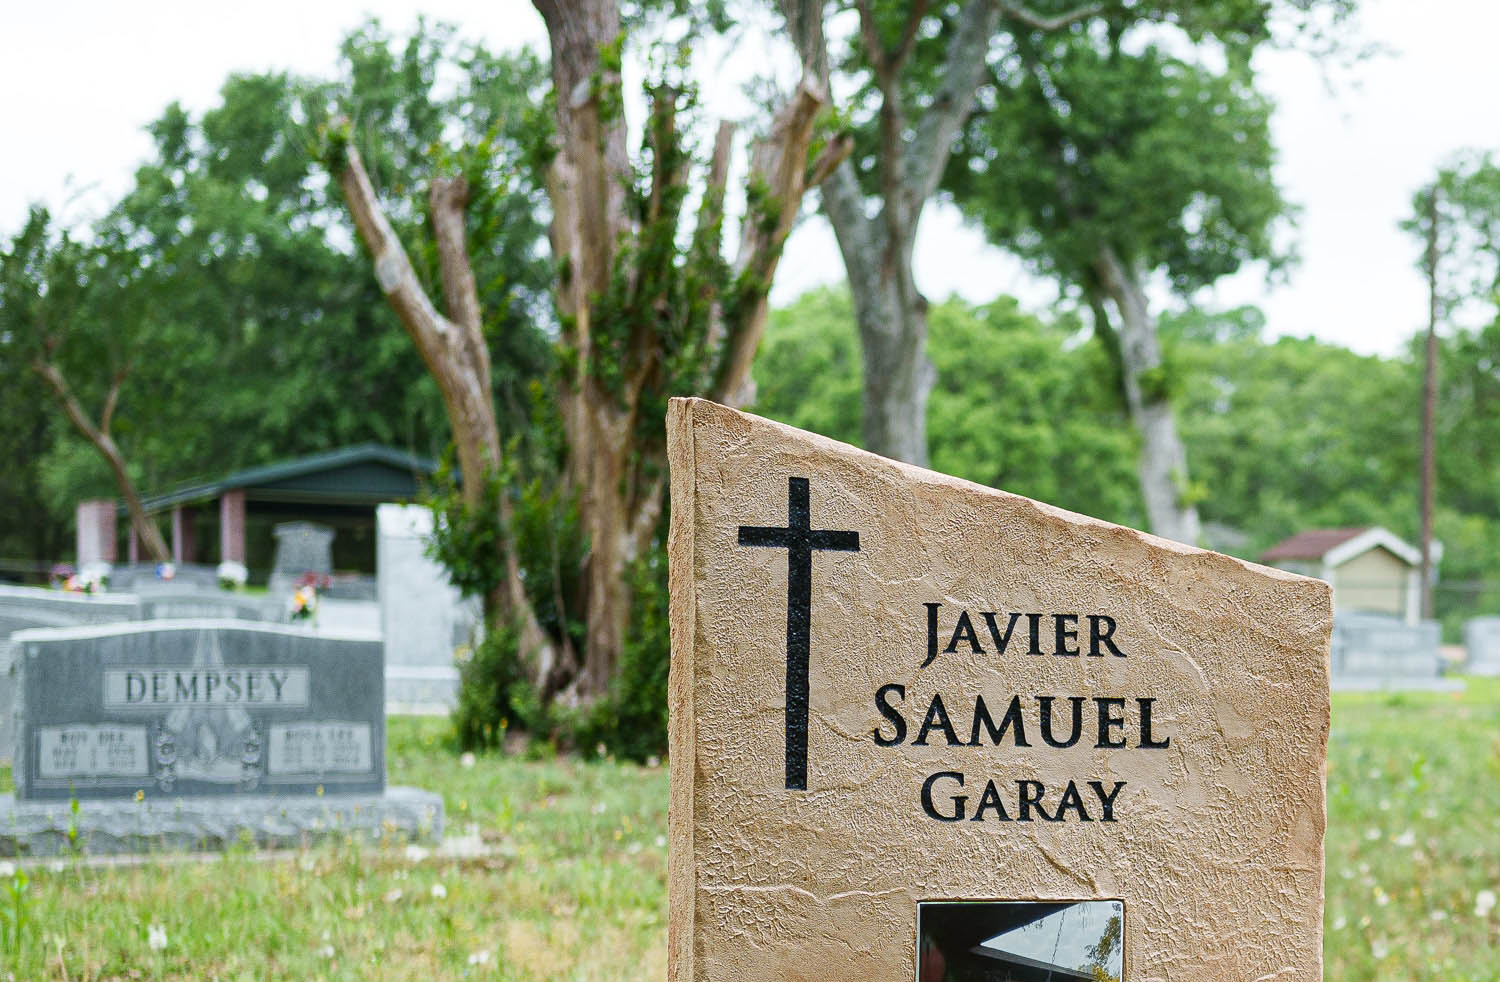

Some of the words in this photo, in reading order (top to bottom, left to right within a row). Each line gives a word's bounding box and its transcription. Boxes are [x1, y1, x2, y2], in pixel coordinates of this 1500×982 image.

[920, 602, 1128, 669] JAVIER
[125, 671, 289, 704] DEMPSEY
[871, 683, 1170, 750] SAMUEL
[920, 771, 1128, 823] GARAY
